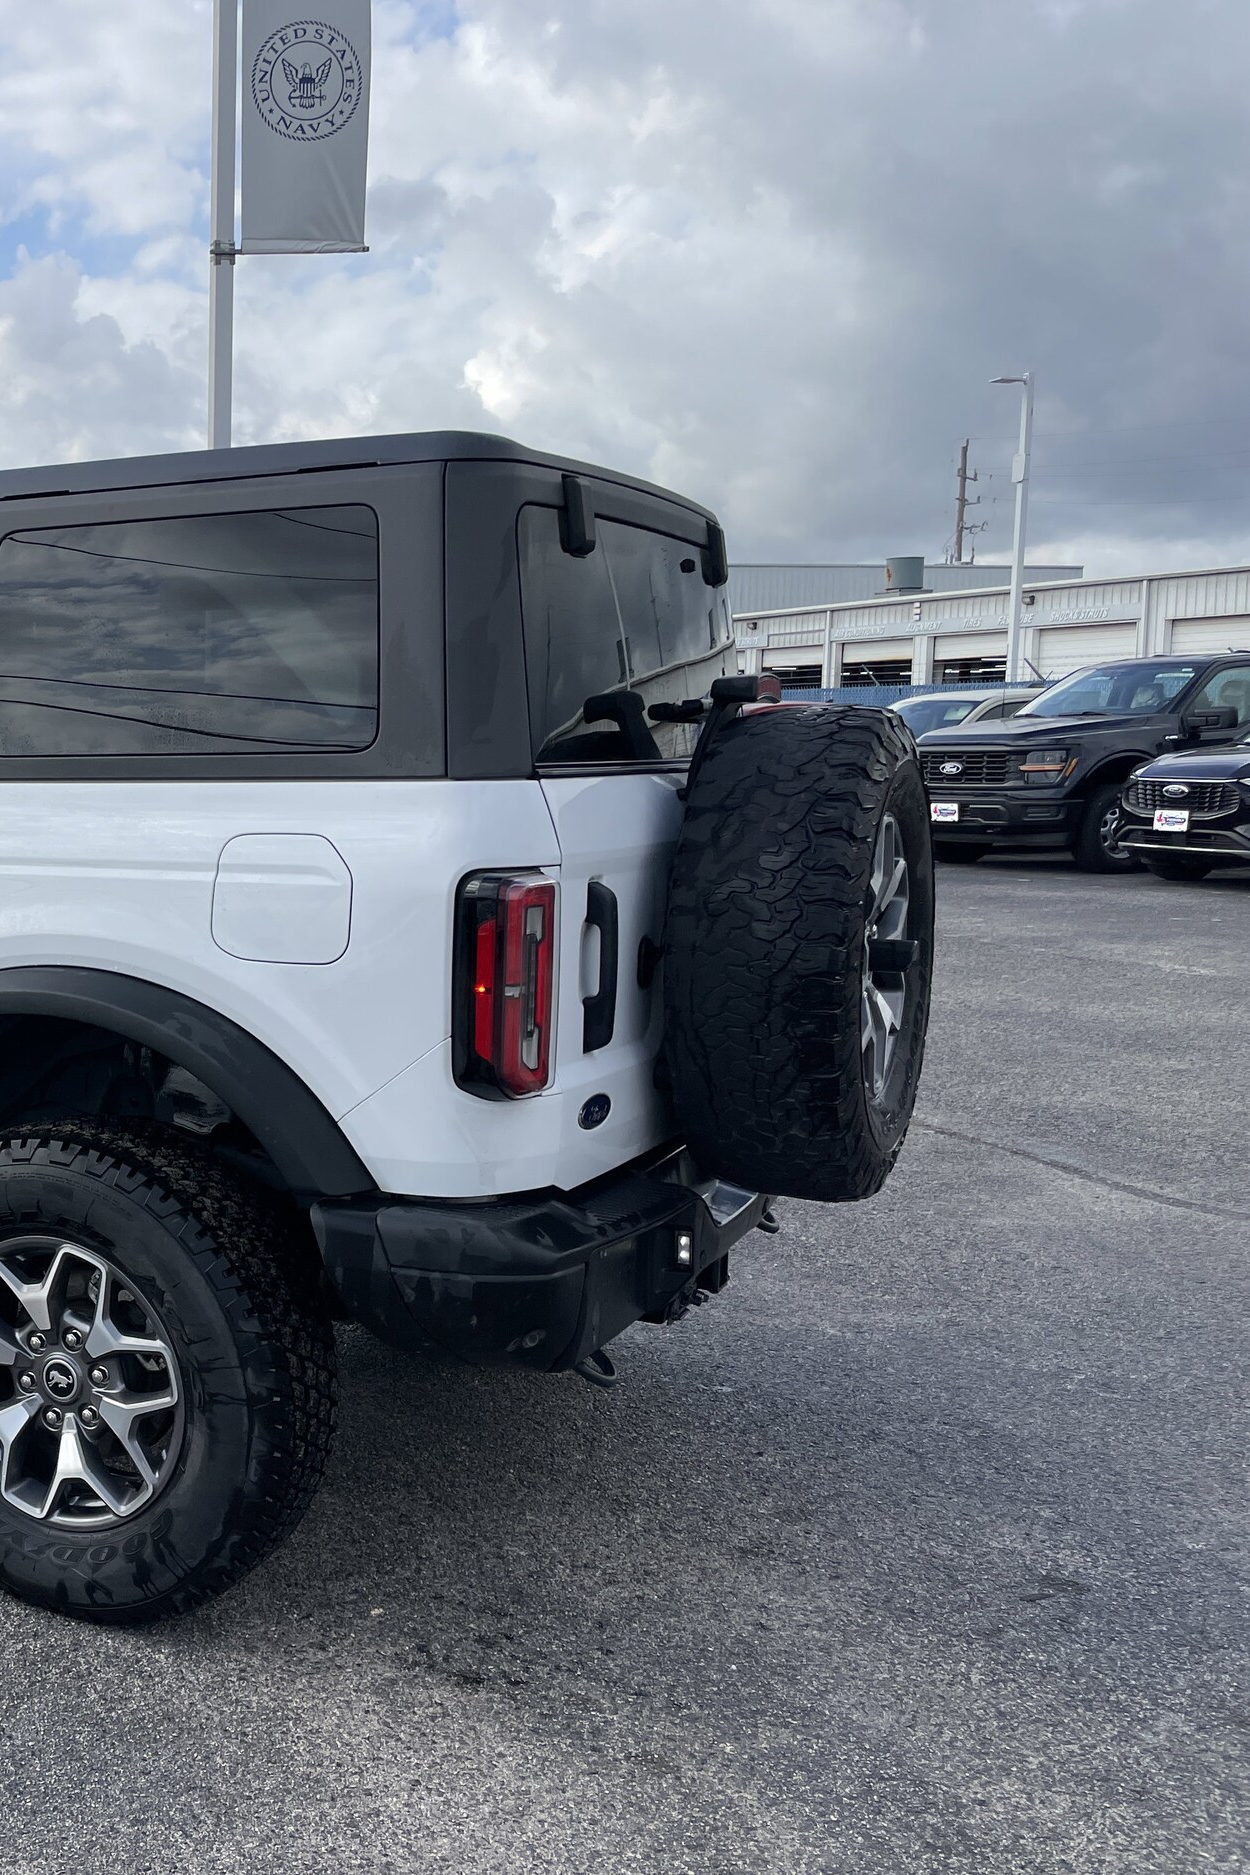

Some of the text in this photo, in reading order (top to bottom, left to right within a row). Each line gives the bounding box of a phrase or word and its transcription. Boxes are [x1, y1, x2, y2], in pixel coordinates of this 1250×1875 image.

[258, 28, 355, 104] UNITED STATES
[276, 113, 336, 135] NAVY
[997, 615, 1010, 626] FAS
